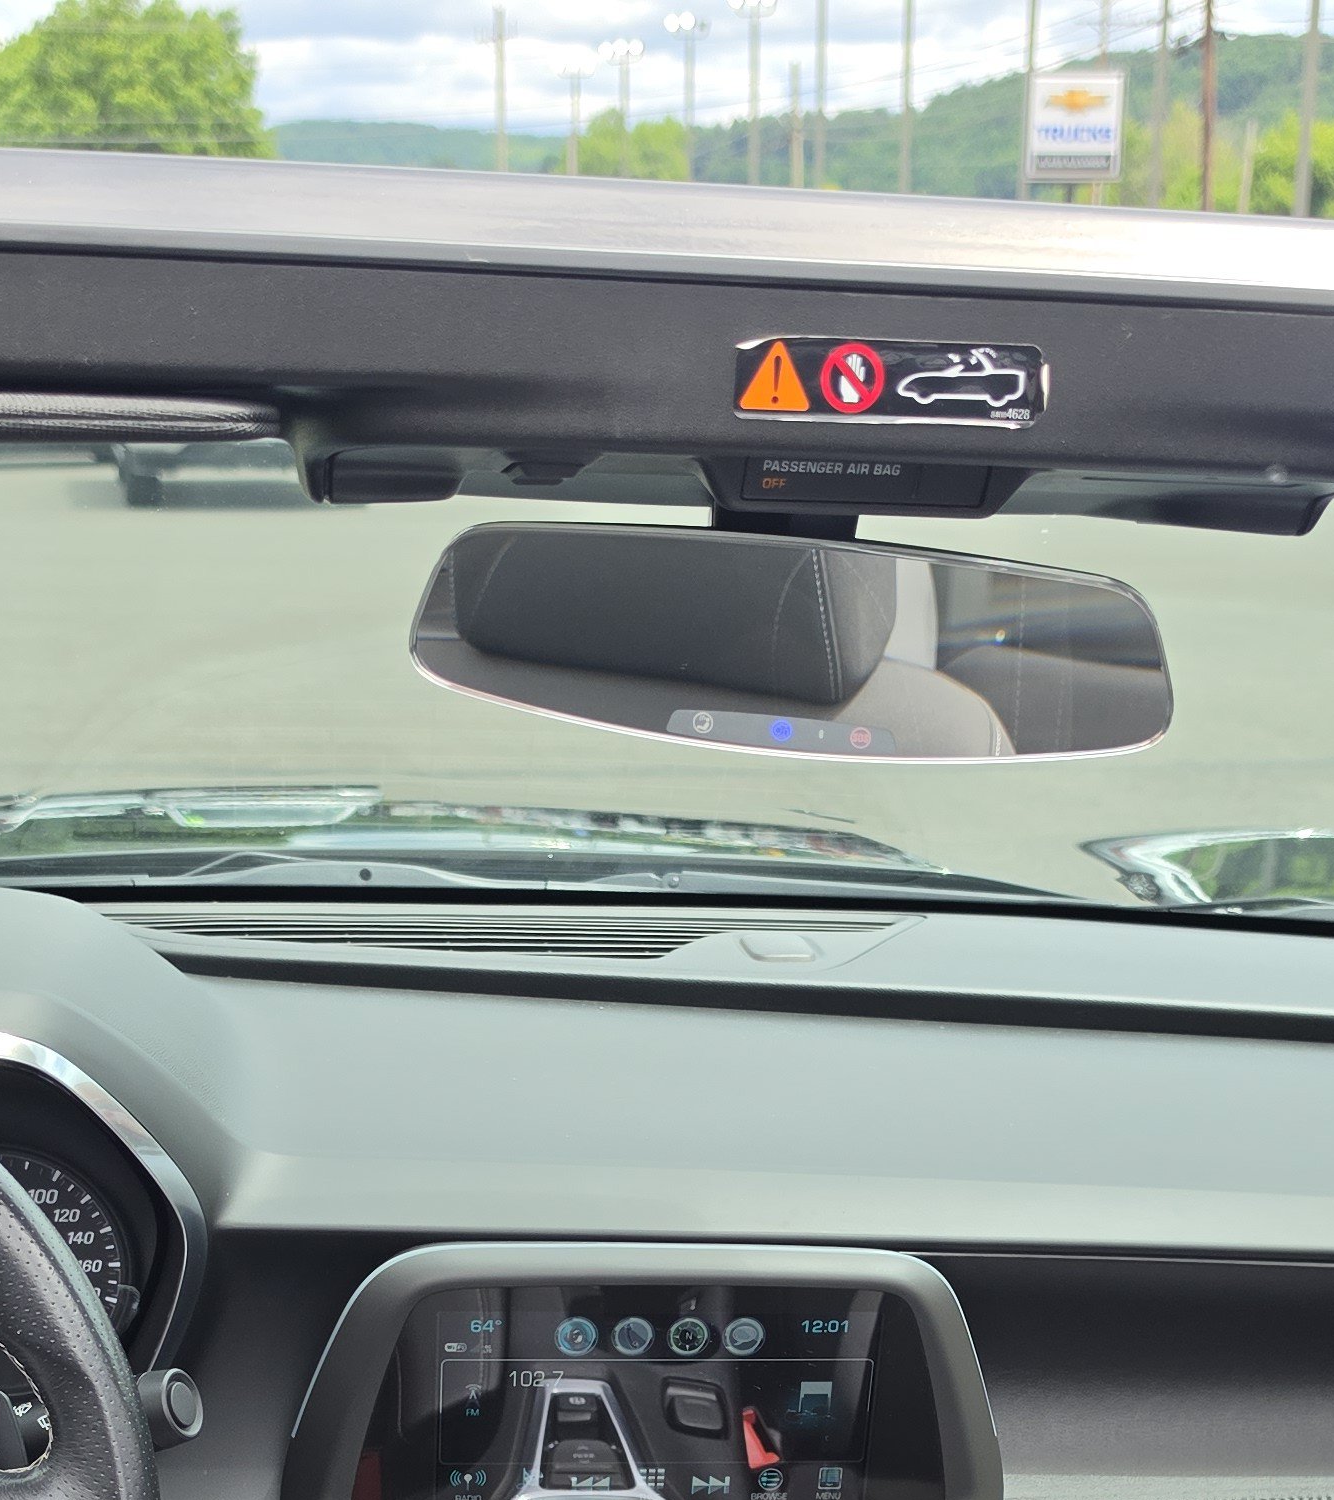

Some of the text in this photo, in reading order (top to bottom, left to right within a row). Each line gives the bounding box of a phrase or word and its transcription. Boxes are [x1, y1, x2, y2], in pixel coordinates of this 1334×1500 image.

[762, 459, 902, 477] PASSENGER AIR BAG
[762, 478, 787, 490] OFF
[28, 1188, 59, 1205] 100
[53, 1208, 81, 1223] 120
[67, 1231, 95, 1245] 140
[469, 1319, 850, 1334] 64° 12:01
[508, 1370, 564, 1387] 102.7
[465, 1408, 480, 1417] FM
[750, 1492, 788, 1500] BROWSE
[816, 1491, 842, 1500] MENU
